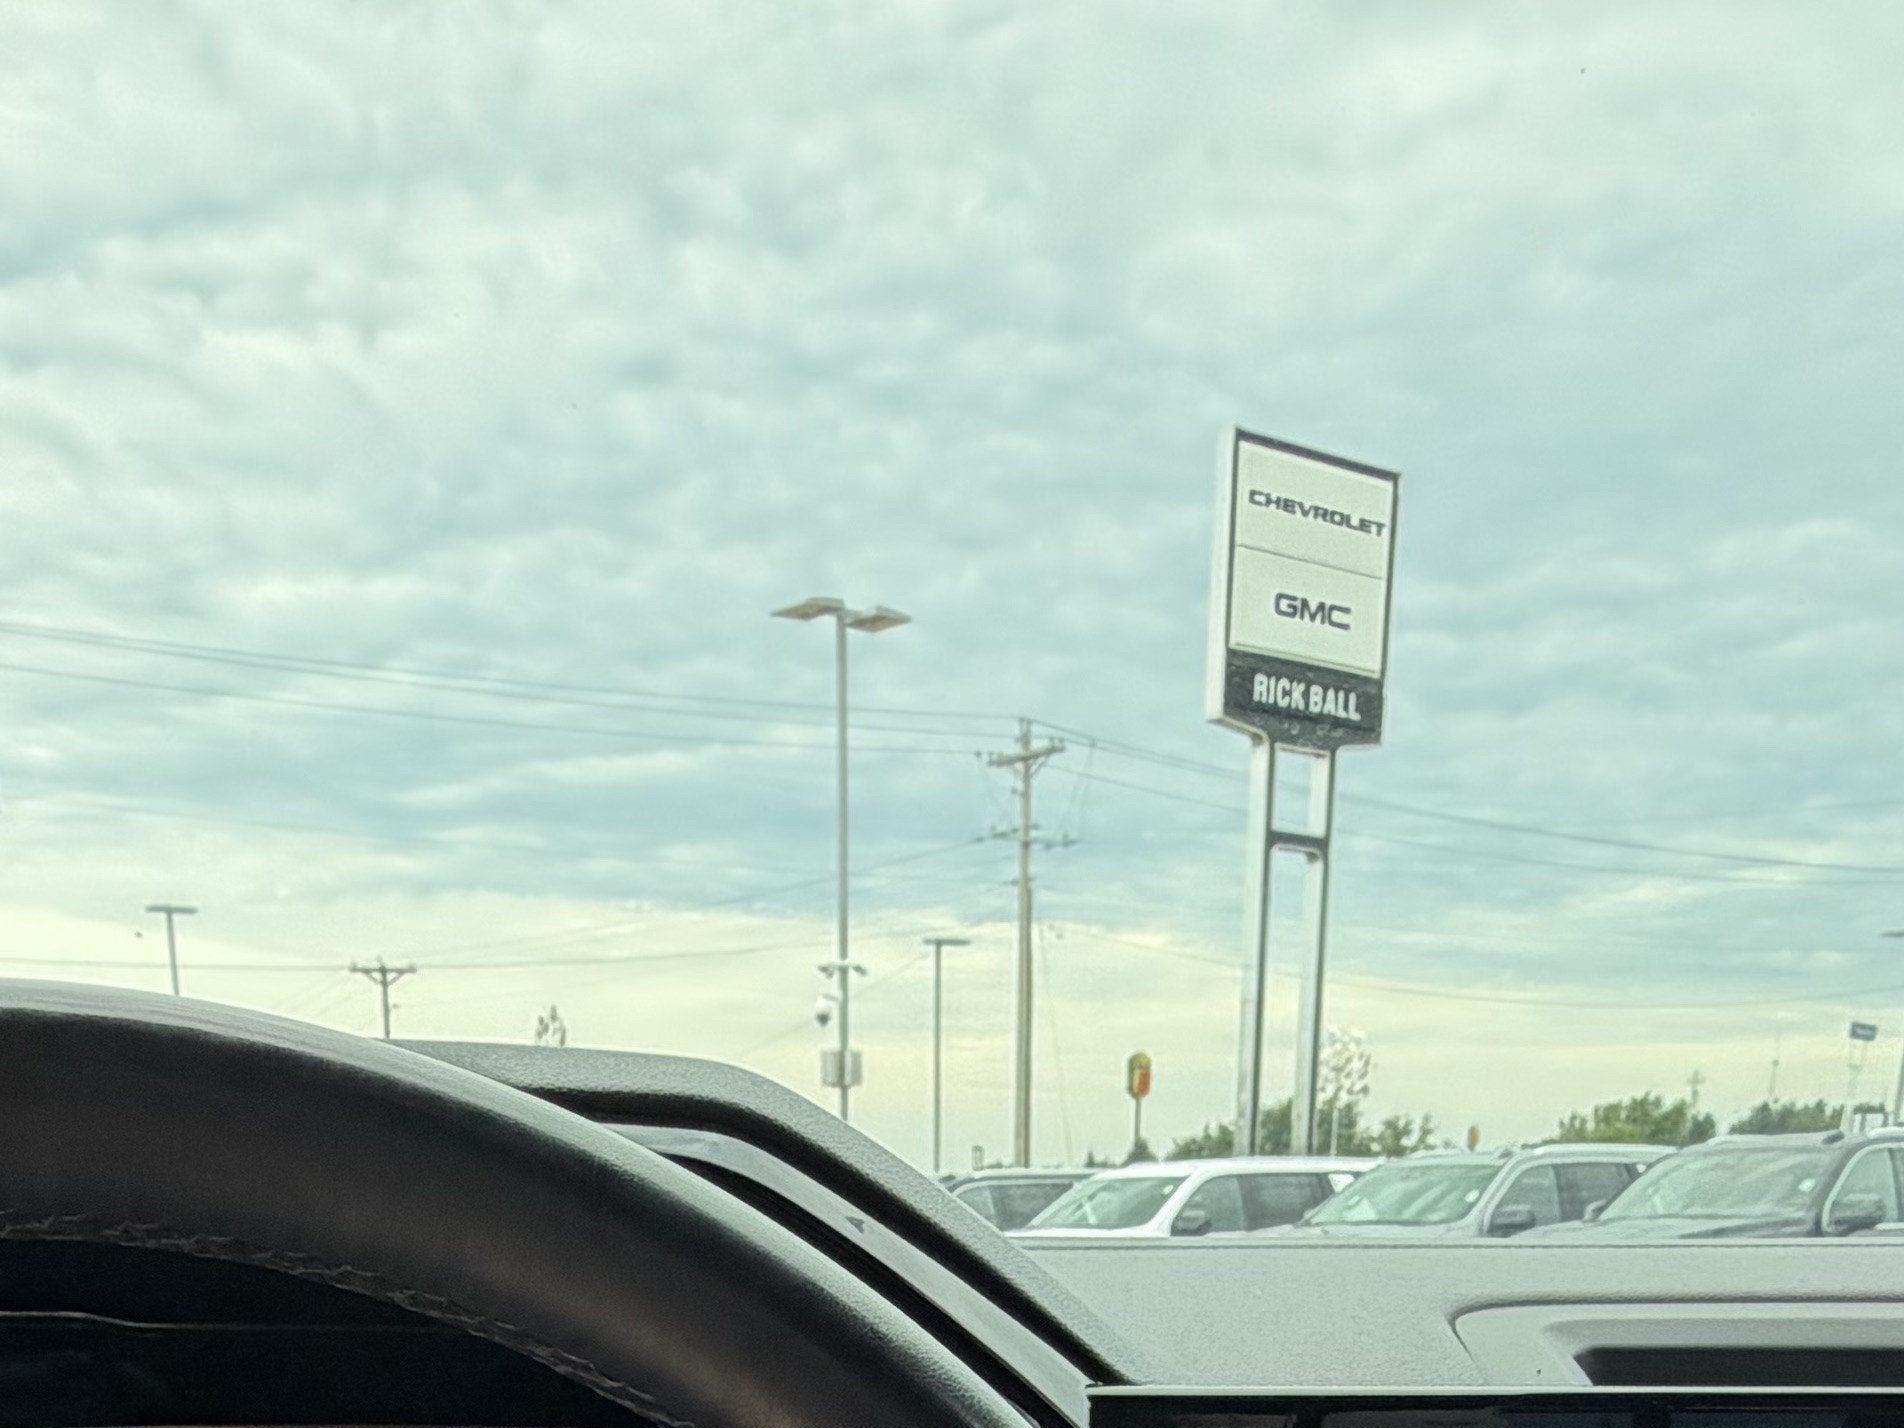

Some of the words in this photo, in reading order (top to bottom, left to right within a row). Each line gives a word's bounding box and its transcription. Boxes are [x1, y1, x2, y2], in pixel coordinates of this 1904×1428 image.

[1249, 489, 1386, 537] CHEVROLET
[1274, 592, 1352, 630] GMC
[1253, 672, 1307, 711] RICK
[1308, 684, 1362, 721] BALL
